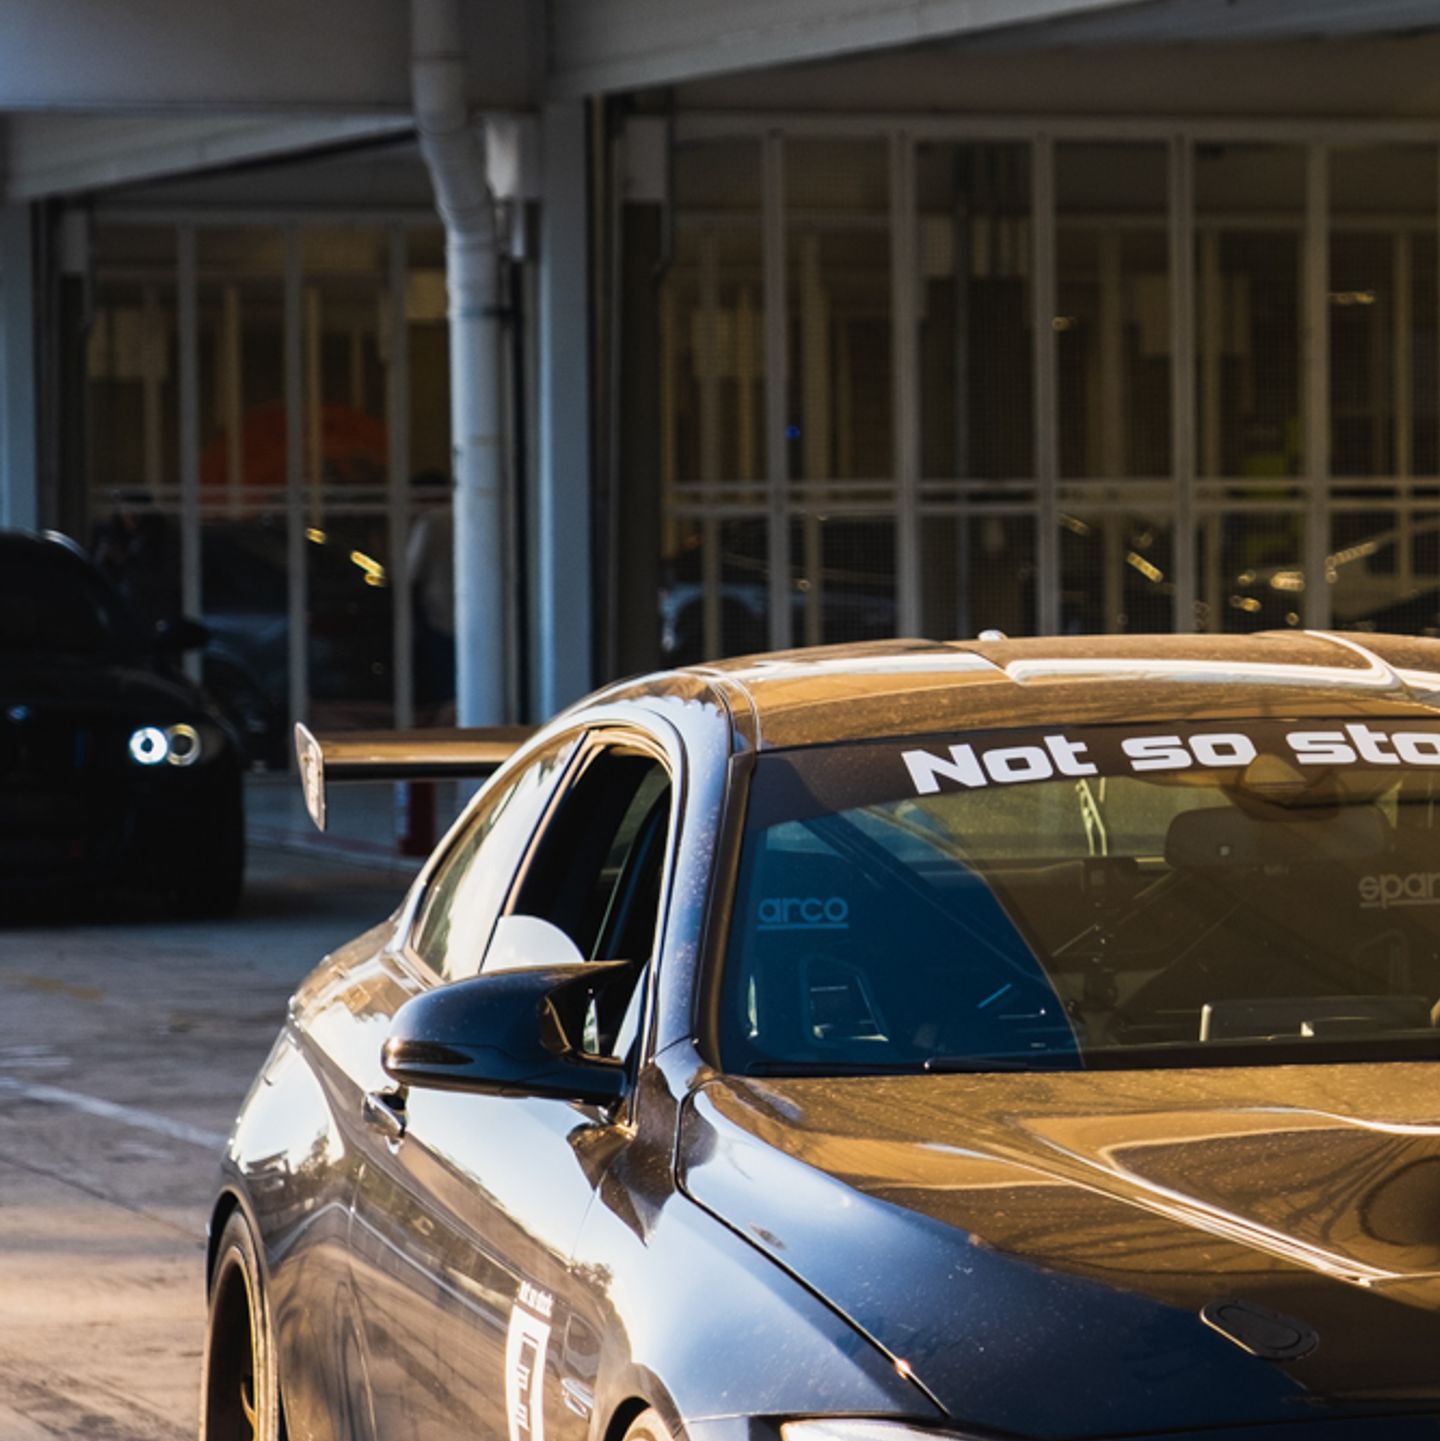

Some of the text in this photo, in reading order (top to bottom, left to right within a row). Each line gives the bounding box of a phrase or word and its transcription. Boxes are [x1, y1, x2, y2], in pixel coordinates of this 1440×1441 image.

[901, 735, 1098, 795] Not
[1121, 733, 1257, 771] so
[758, 896, 848, 923] arco
